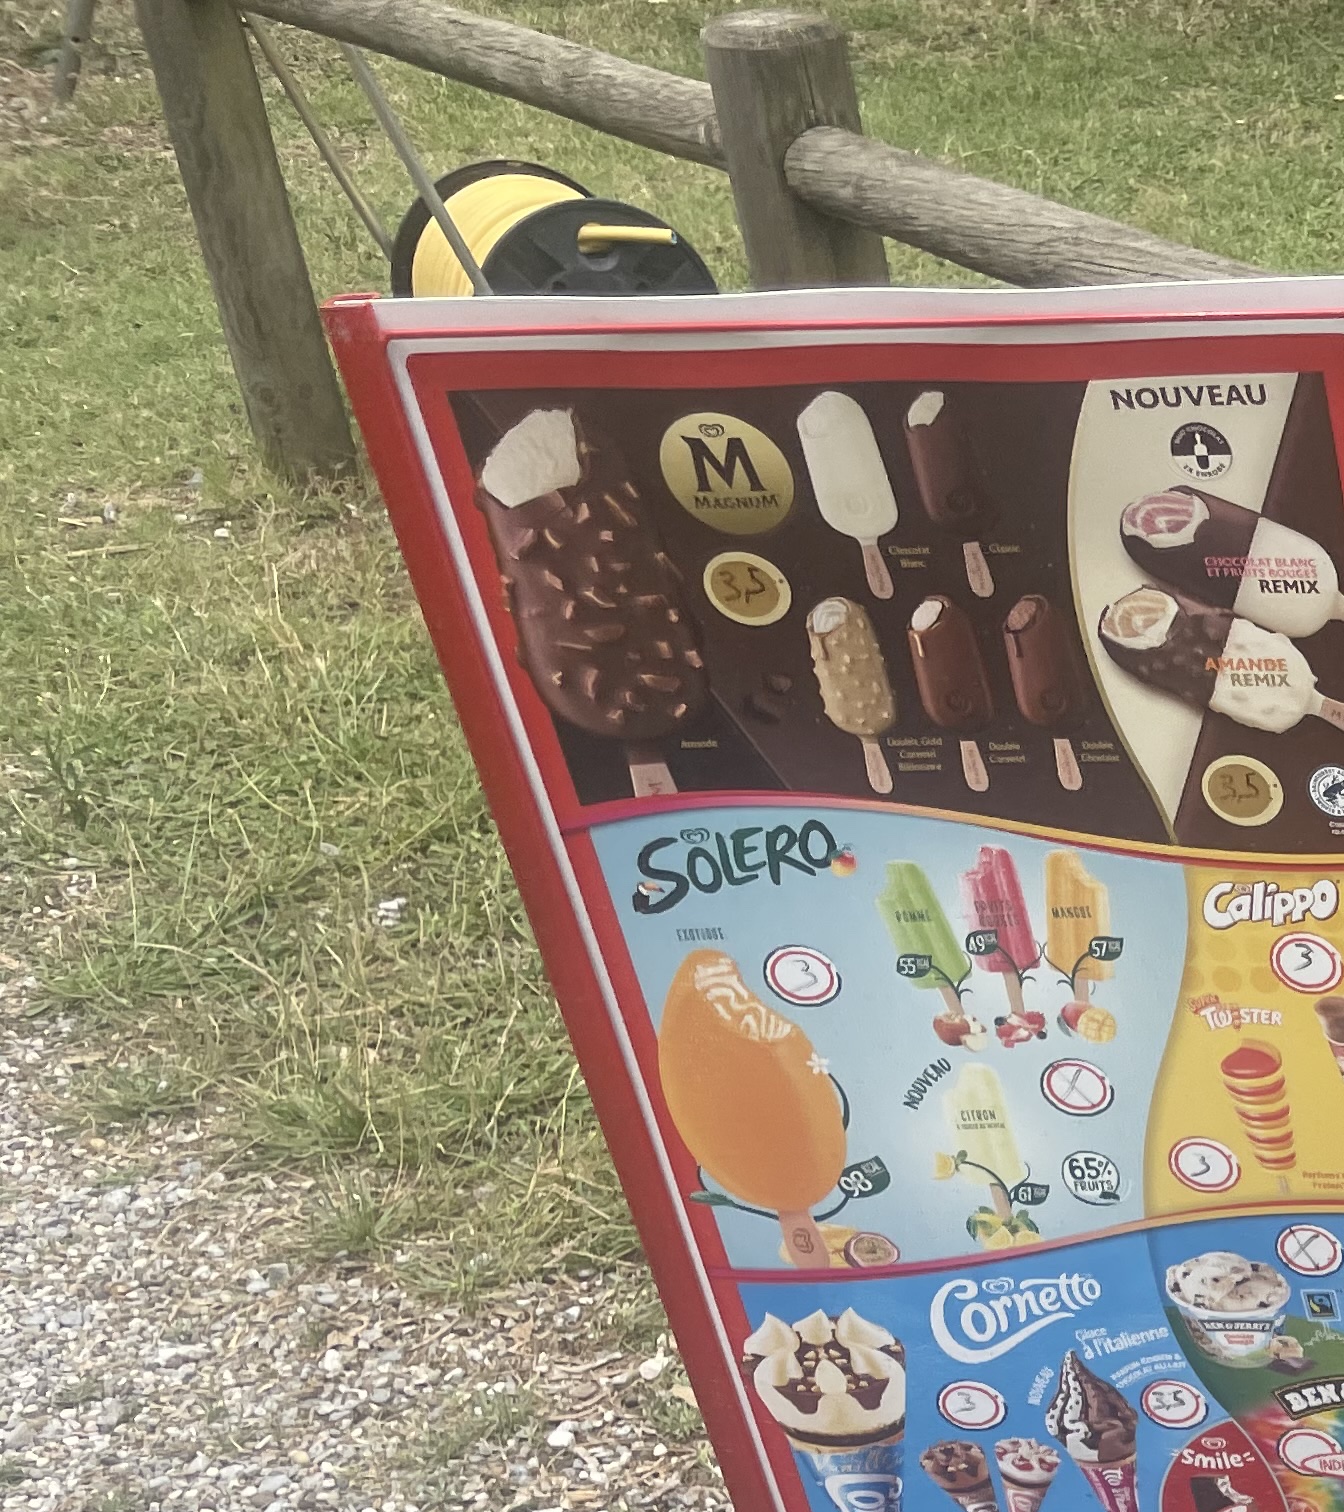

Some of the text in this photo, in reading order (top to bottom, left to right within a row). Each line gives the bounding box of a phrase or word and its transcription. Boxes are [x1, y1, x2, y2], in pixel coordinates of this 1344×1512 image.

[1110, 384, 1268, 410] NOUVEAU
[680, 435, 768, 492] M
[694, 494, 779, 510] MAGNUM
[1204, 556, 1317, 568] CHOCOLAT BLANC
[1206, 567, 1318, 578] ET FRUITS ROUGES
[1259, 579, 1320, 594] REMIX
[1204, 657, 1289, 672] AMANDE
[1231, 673, 1291, 687] REMIX
[632, 819, 838, 914] SOLERO
[1203, 879, 1339, 930] Calippo
[968, 935, 985, 953] 49
[1090, 940, 1108, 957] 57
[1294, 942, 1313, 971] 3
[900, 957, 917, 975] 55
[902, 1057, 952, 1111] NOUVEAU
[960, 1109, 997, 1122] CITRON
[1069, 1157, 1112, 1180] 65%
[840, 1170, 873, 1198] 98
[1074, 1179, 1114, 1194] FRUITS
[1018, 1186, 1032, 1202] 61
[930, 1272, 1102, 1364] Cornetto
[1284, 1383, 1340, 1413] BEN
[1181, 1449, 1244, 1470] Smile
